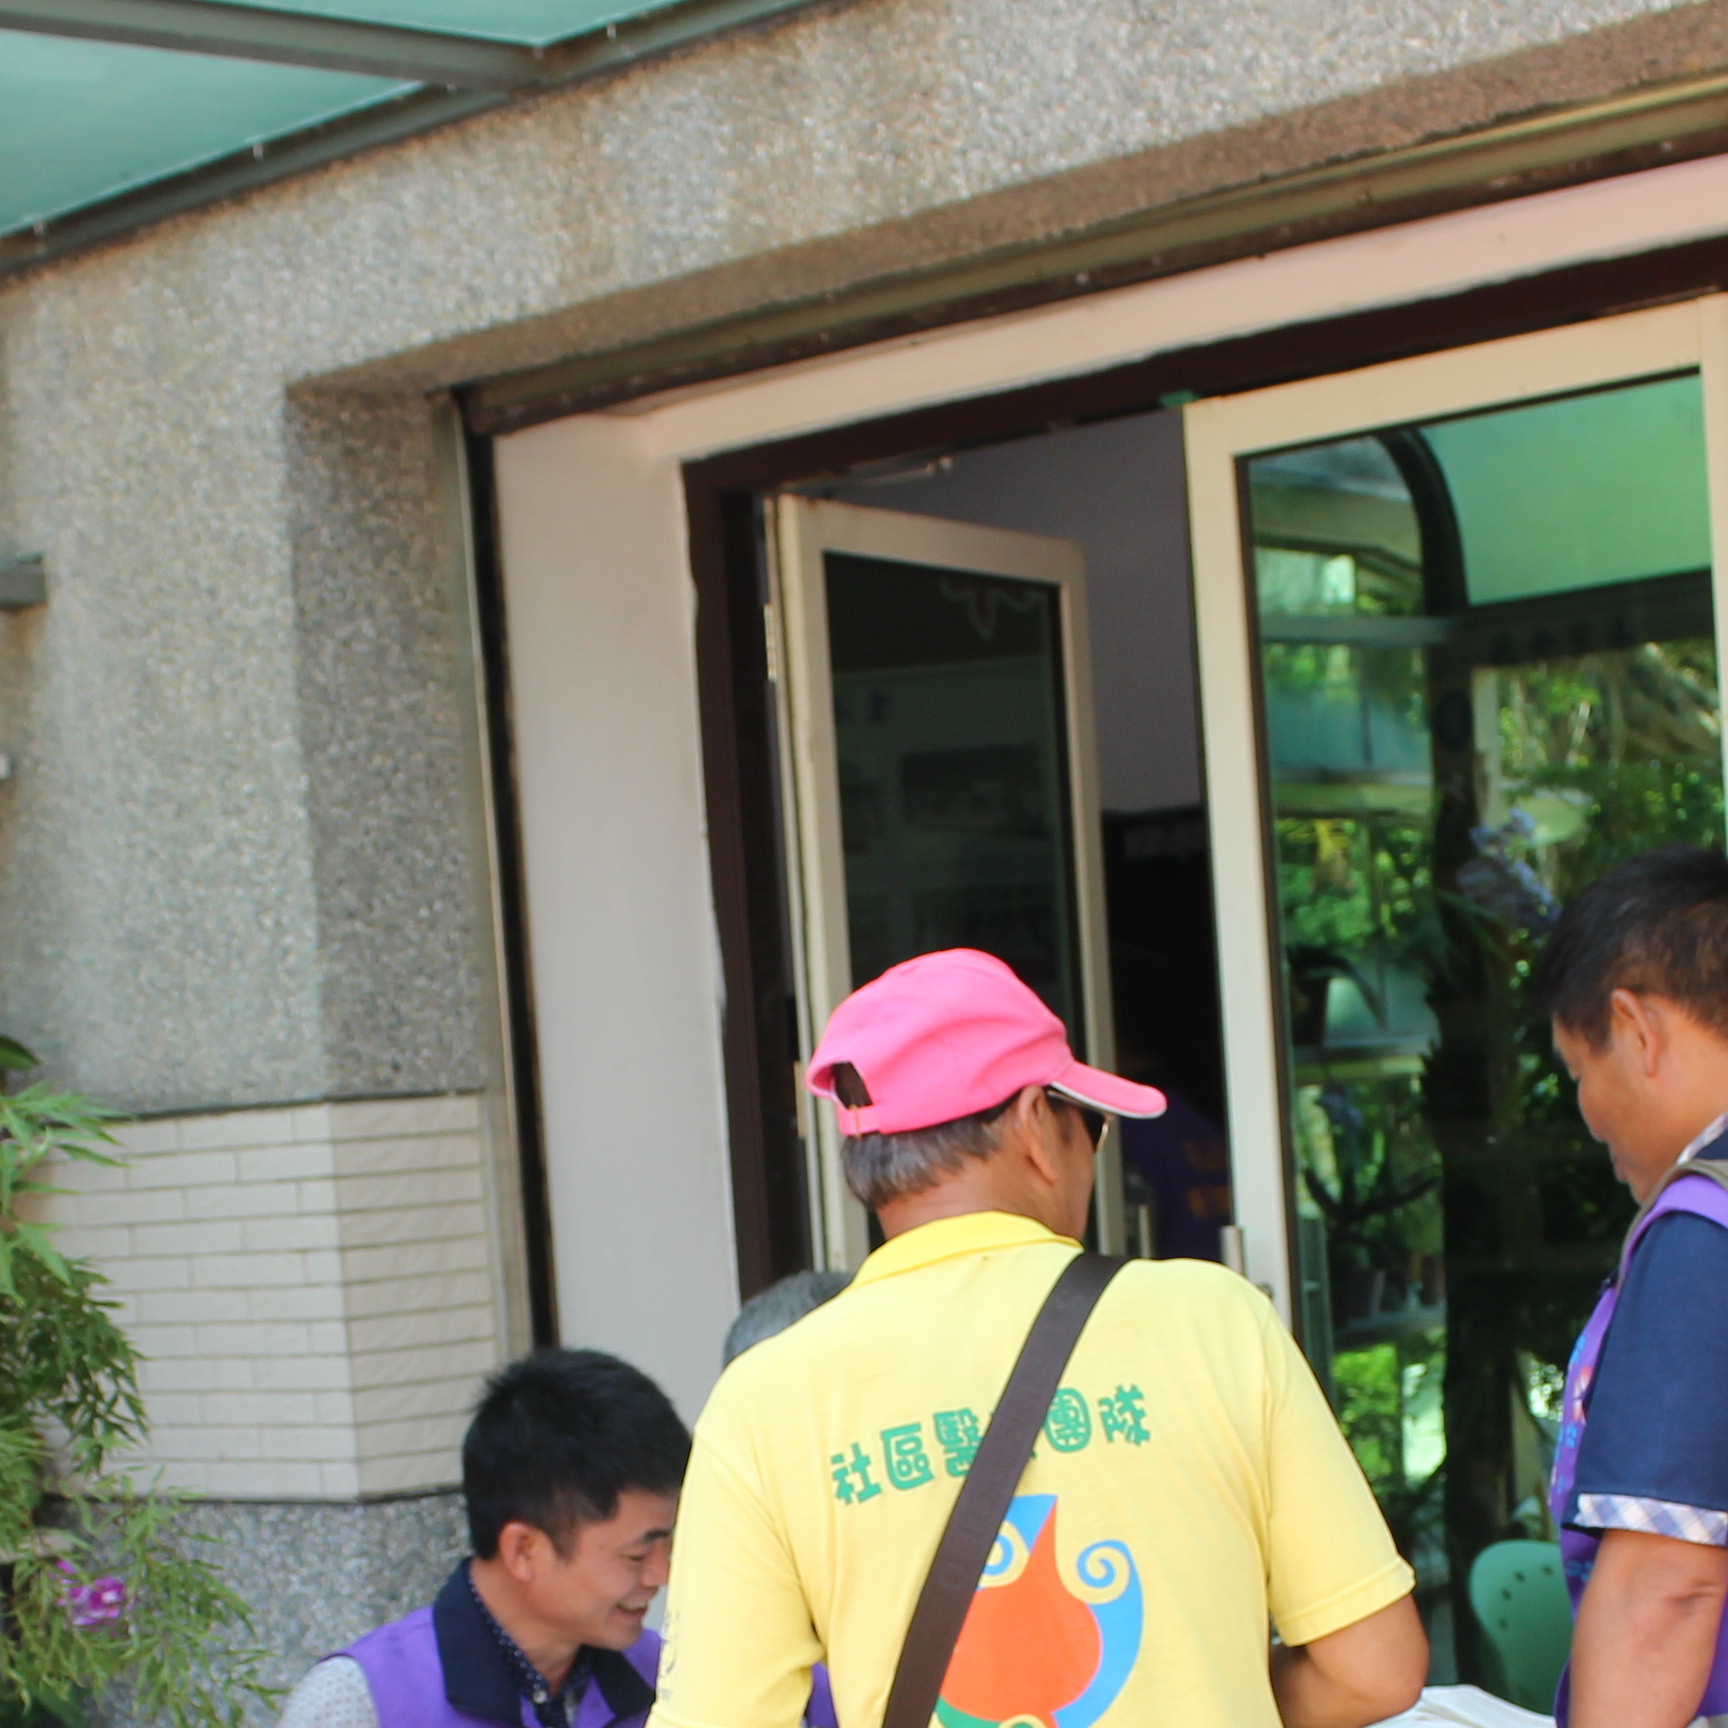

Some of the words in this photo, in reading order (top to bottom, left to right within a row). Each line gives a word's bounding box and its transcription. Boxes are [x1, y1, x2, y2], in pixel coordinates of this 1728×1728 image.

[830, 1384, 1153, 1506] 社區醫團隊
